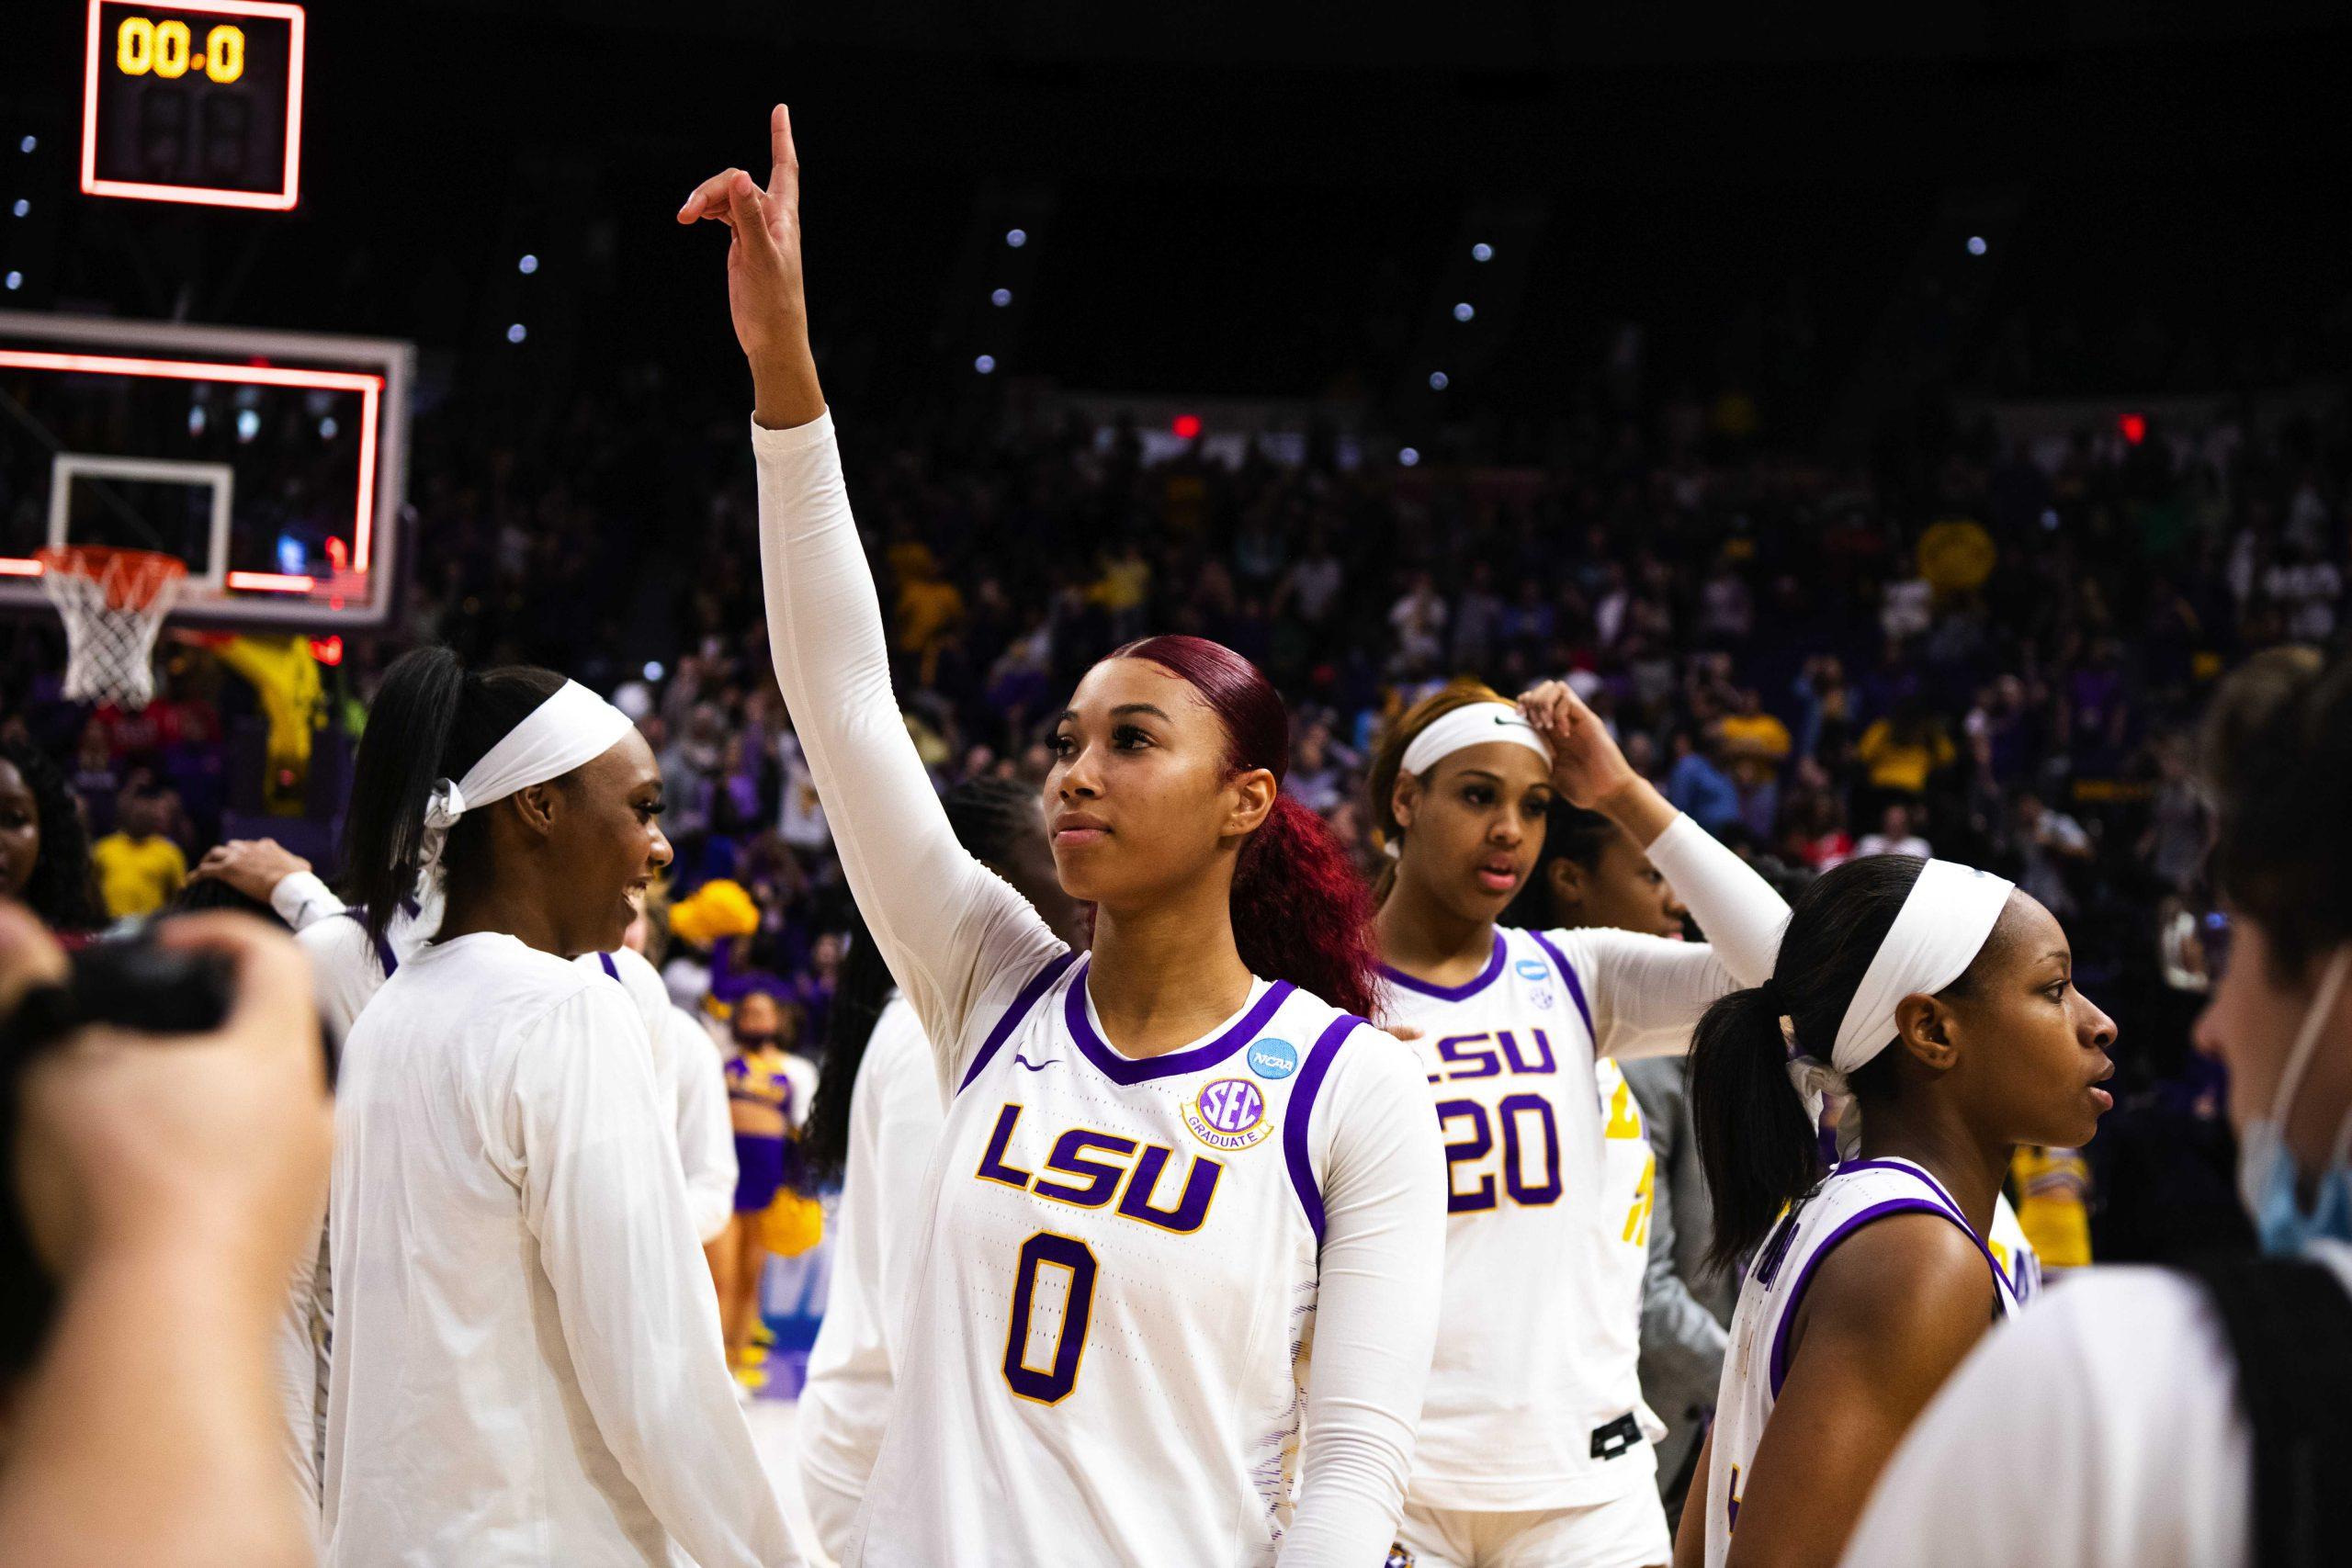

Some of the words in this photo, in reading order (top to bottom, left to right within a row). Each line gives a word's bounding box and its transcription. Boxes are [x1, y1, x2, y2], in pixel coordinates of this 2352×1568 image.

[117, 17, 245, 84] 00.0
[1253, 1052, 1295, 1072] NCAA
[1428, 1028, 1557, 1084] SU
[1188, 1116, 1258, 1147] GRADUATE
[1202, 1080, 1261, 1131] SEC
[975, 1103, 1226, 1235] LSU
[1435, 1093, 1563, 1215] 20
[1001, 1229, 1100, 1407] 0
